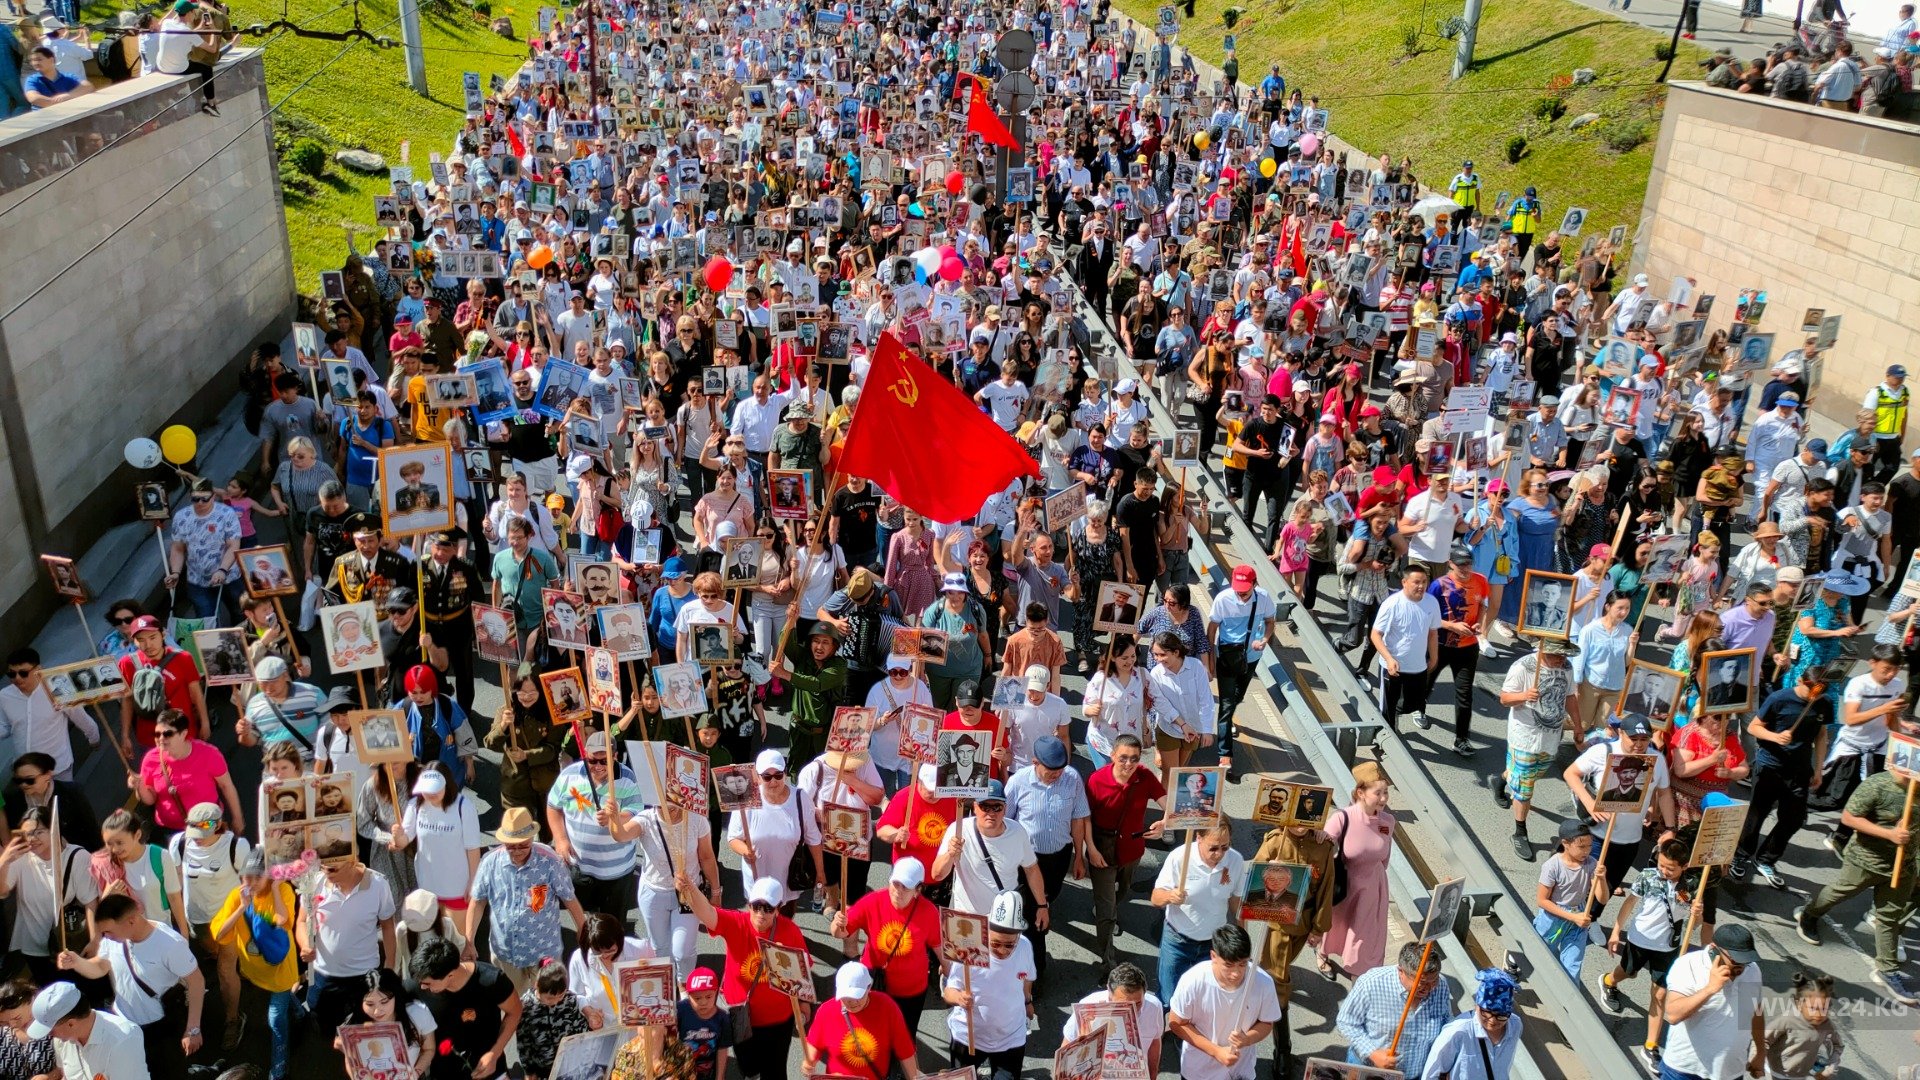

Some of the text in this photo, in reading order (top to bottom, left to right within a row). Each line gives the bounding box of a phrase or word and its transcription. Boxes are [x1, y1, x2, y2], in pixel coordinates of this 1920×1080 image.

[427, 416, 437, 427] IT
[418, 820, 455, 832] bonjour
[690, 976, 714, 989] UFC
